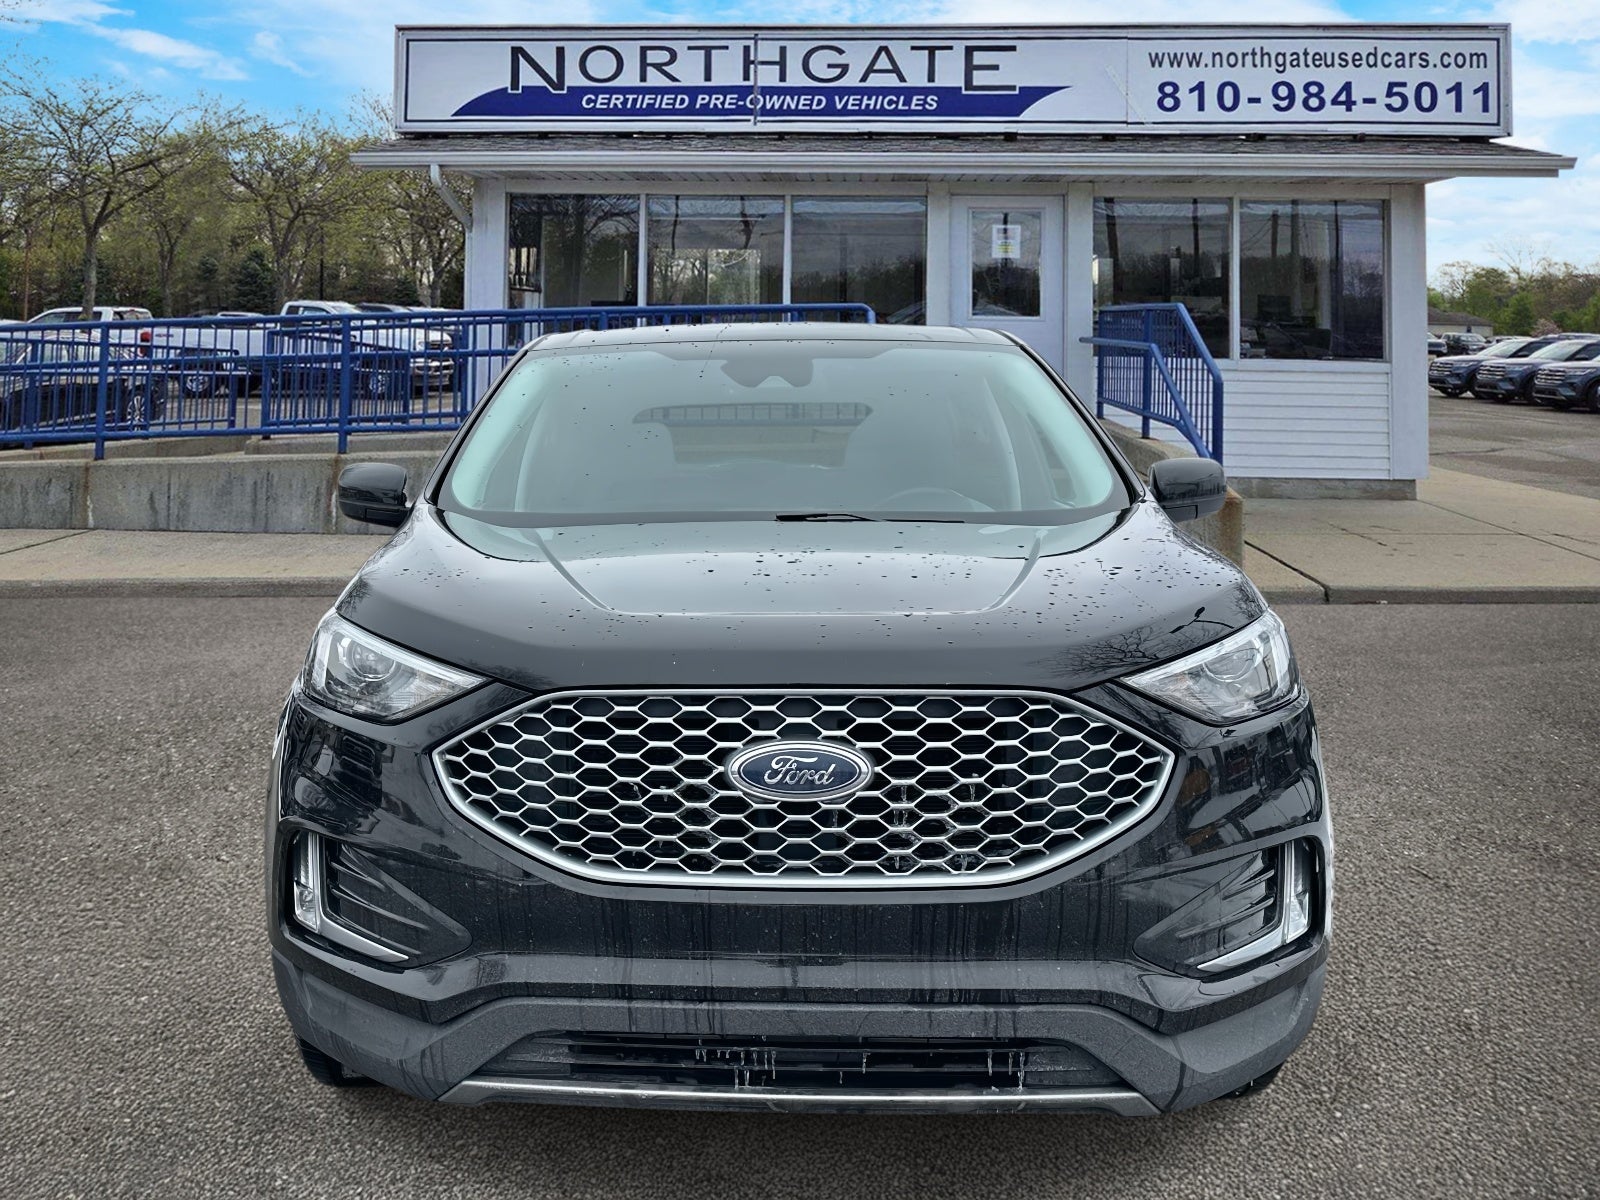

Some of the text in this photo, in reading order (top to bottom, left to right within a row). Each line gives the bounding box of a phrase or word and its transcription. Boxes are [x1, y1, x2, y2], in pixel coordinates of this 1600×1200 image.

[510, 44, 1018, 93] NORTHGATE
[1148, 46, 1488, 74] www.northgateusedcars.com
[581, 94, 939, 111] CERTIFIED PRE-OWNED VEHICLES
[1156, 80, 1490, 113] 810-984-5011
[763, 755, 836, 785] Ford
